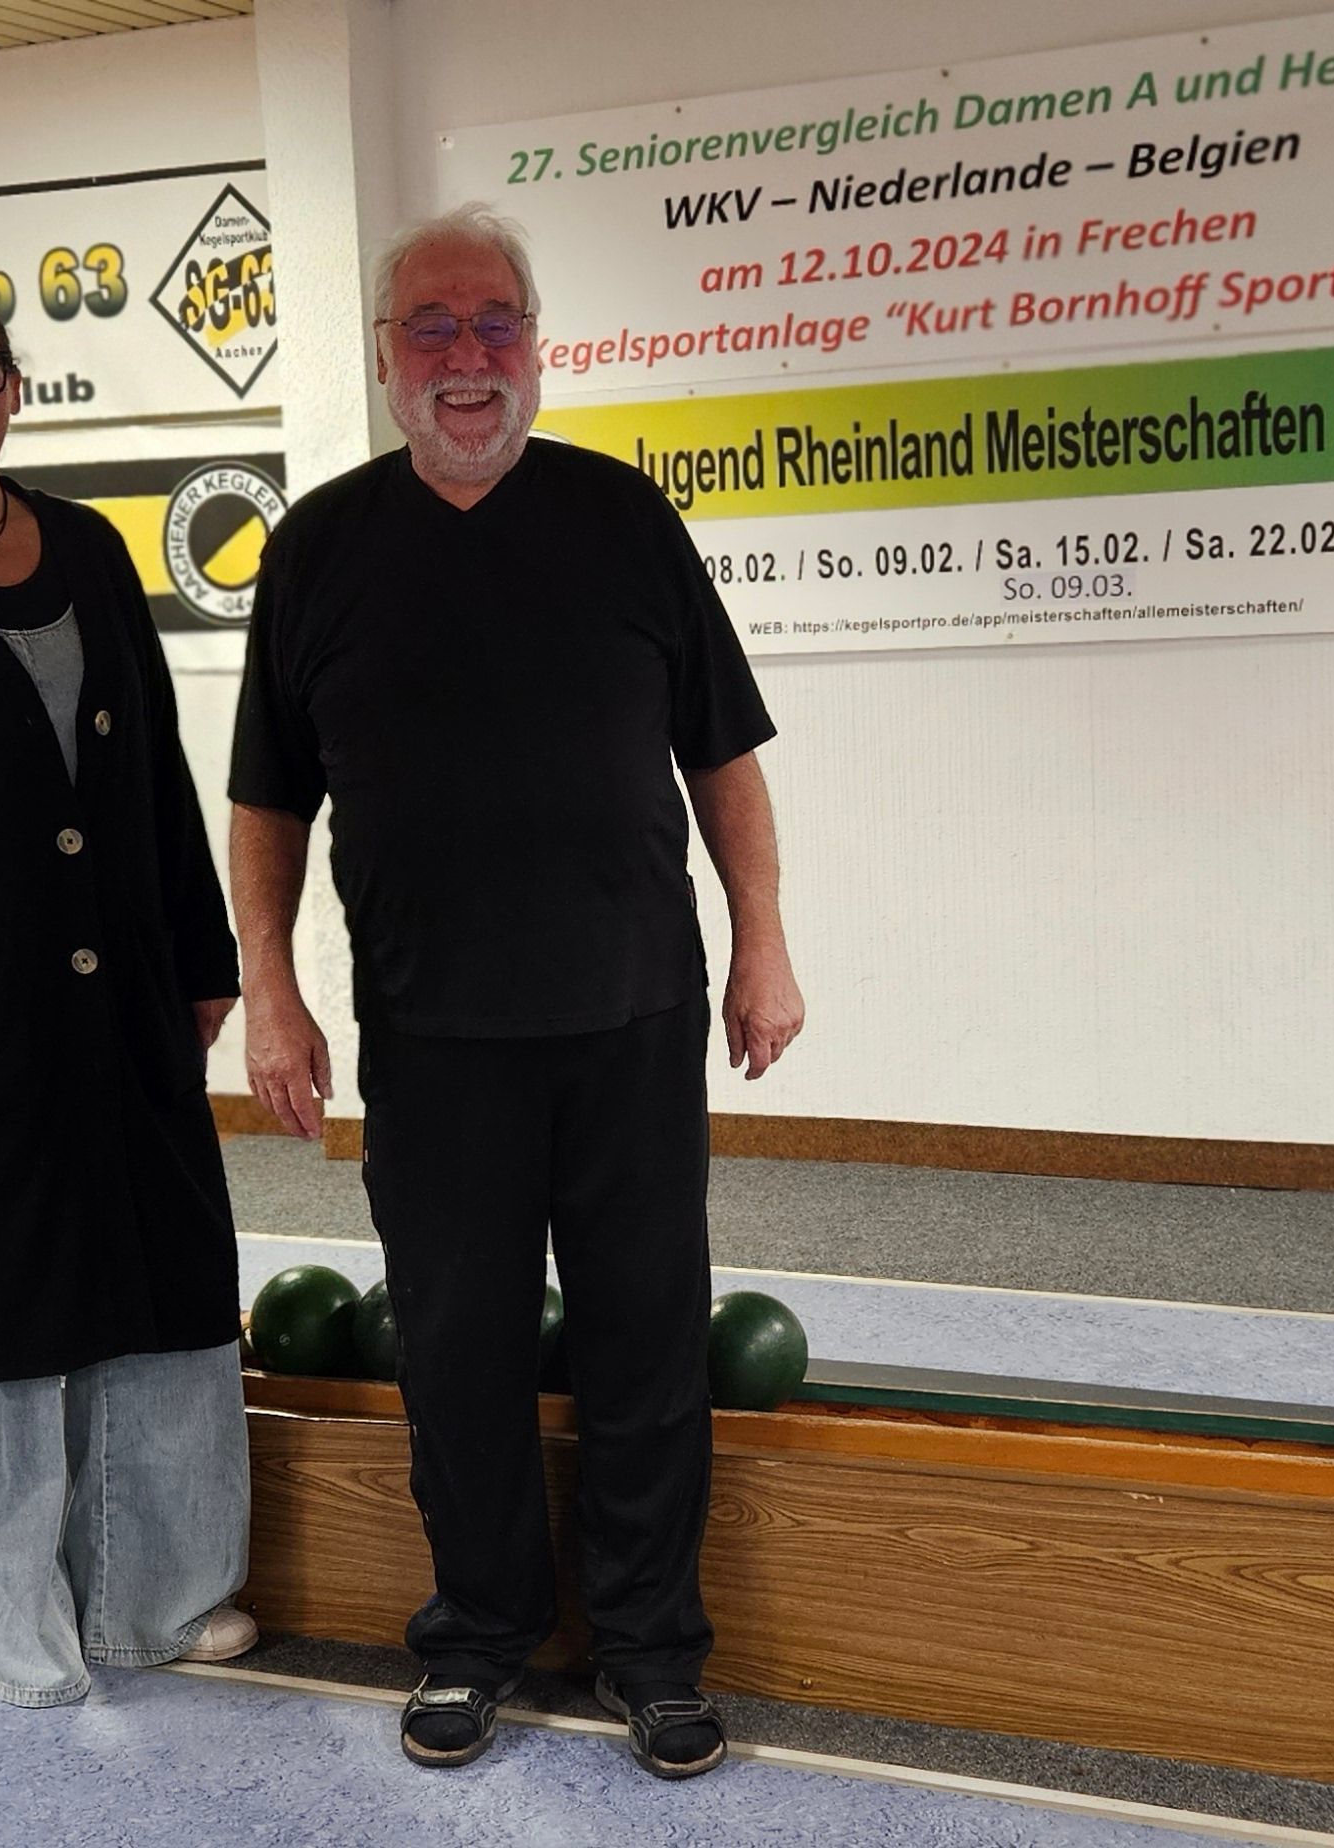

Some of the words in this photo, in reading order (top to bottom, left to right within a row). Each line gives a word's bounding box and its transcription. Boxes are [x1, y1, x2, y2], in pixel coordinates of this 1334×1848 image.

[506, 147, 564, 185] 27.
[575, 97, 940, 178] Seniorenvergleich
[953, 83, 1113, 131] Damen
[1126, 71, 1159, 109] A
[1175, 56, 1267, 103] und
[663, 186, 763, 230] WKV
[807, 152, 1073, 214] Niederlande
[1126, 129, 1302, 179] Belgien
[39, 242, 129, 322] 63
[699, 261, 764, 294] am
[776, 228, 1010, 287] 12.10.2024
[1022, 224, 1062, 261] in
[1076, 207, 1258, 255] Frechen
[1009, 271, 1210, 328] Bornhoff
[775, 413, 973, 488] Rheinland
[986, 390, 1326, 475] Meisterschaften
[170, 486, 209, 600] AACHENER
[202, 472, 279, 516] KEGLER
[817, 549, 863, 579] So.
[875, 542, 963, 577] 09.02.
[995, 538, 1042, 571] Sa.
[1056, 532, 1150, 567] 15.02.
[1185, 527, 1235, 561] Sa.
[749, 622, 788, 635] WEB:
[793, 597, 1304, 634] https://kegelsportpro.de/app/meisterschaften/allemeisterschaften/
[1003, 577, 1042, 600] So.
[1051, 574, 1132, 599] 09.03.
